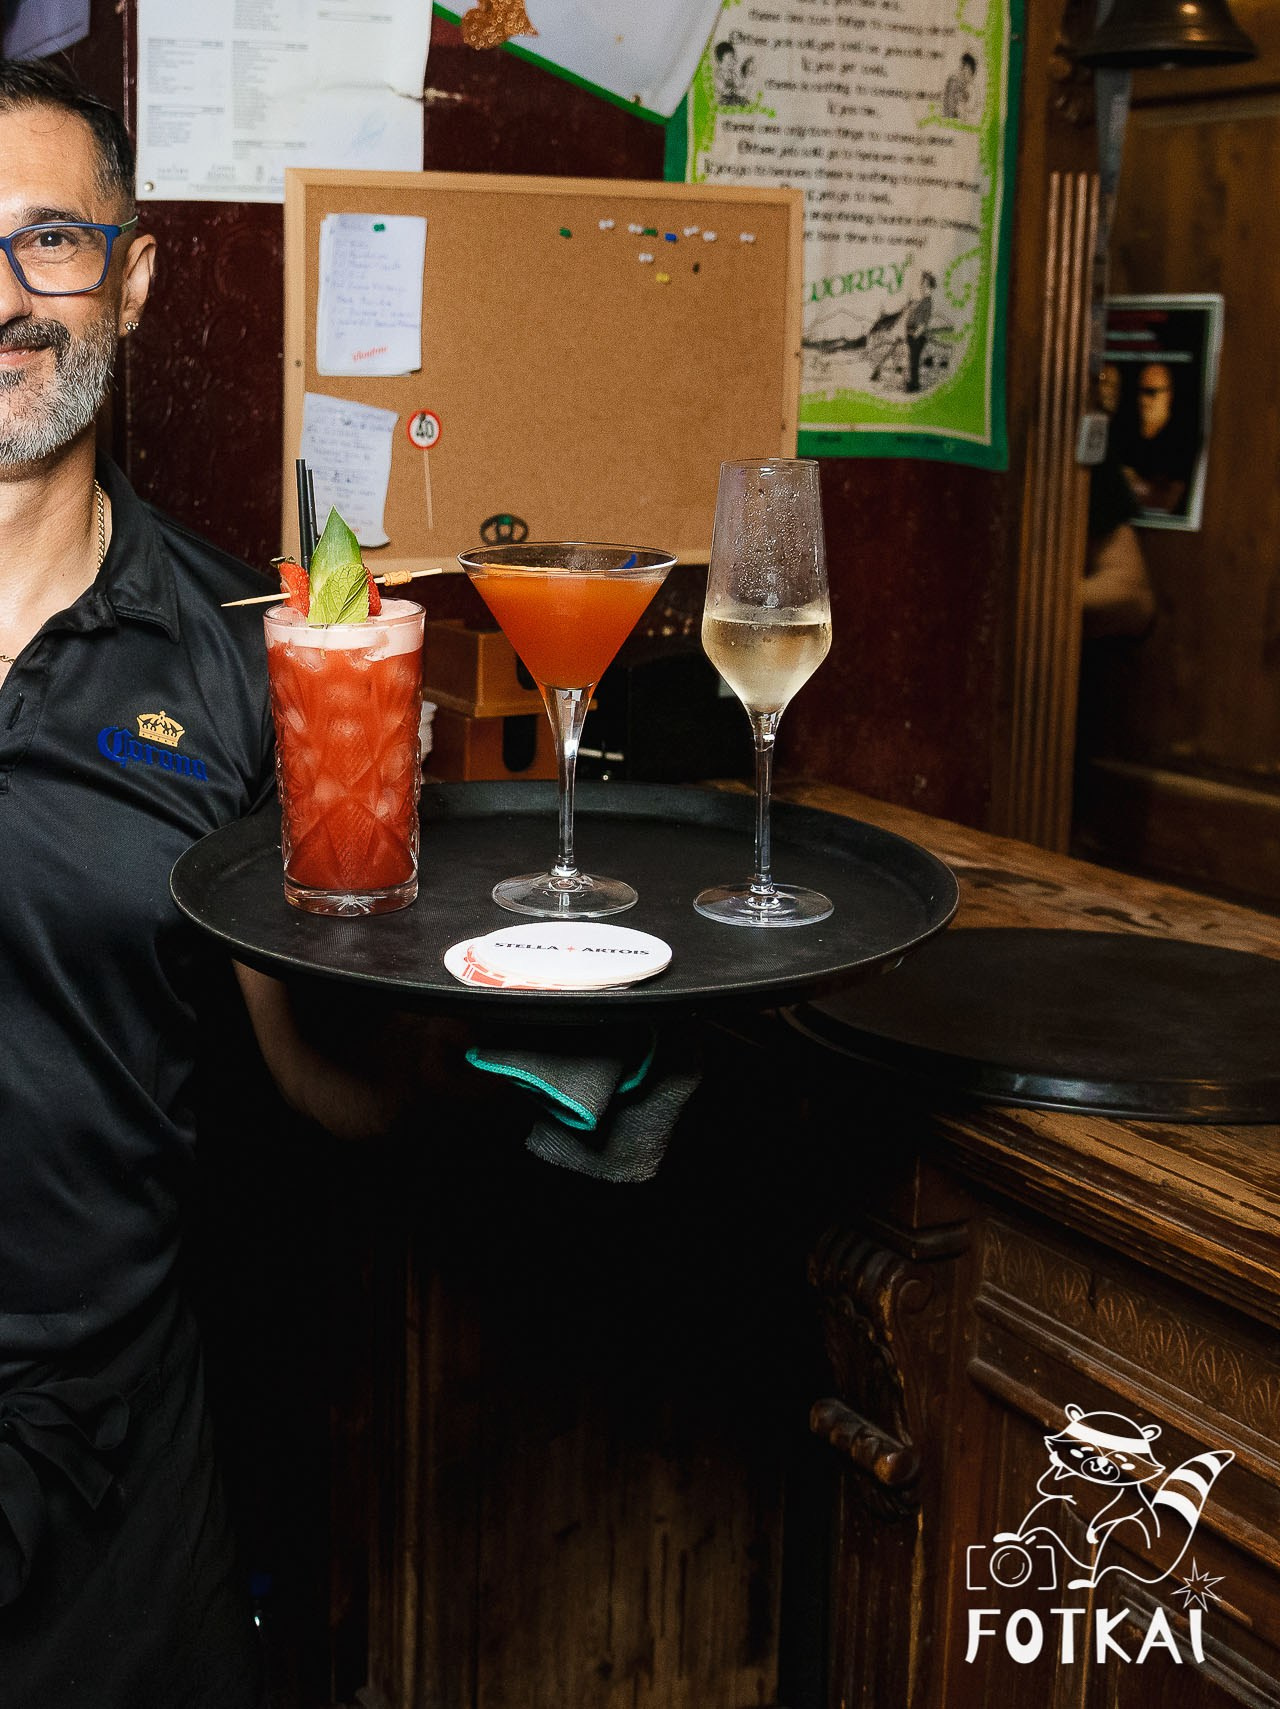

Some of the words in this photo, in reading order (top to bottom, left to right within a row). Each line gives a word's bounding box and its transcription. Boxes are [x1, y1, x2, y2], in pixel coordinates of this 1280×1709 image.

[97, 725, 209, 782] Corona
[495, 942, 560, 951] STELLA
[582, 946, 651, 955] ARTOIS
